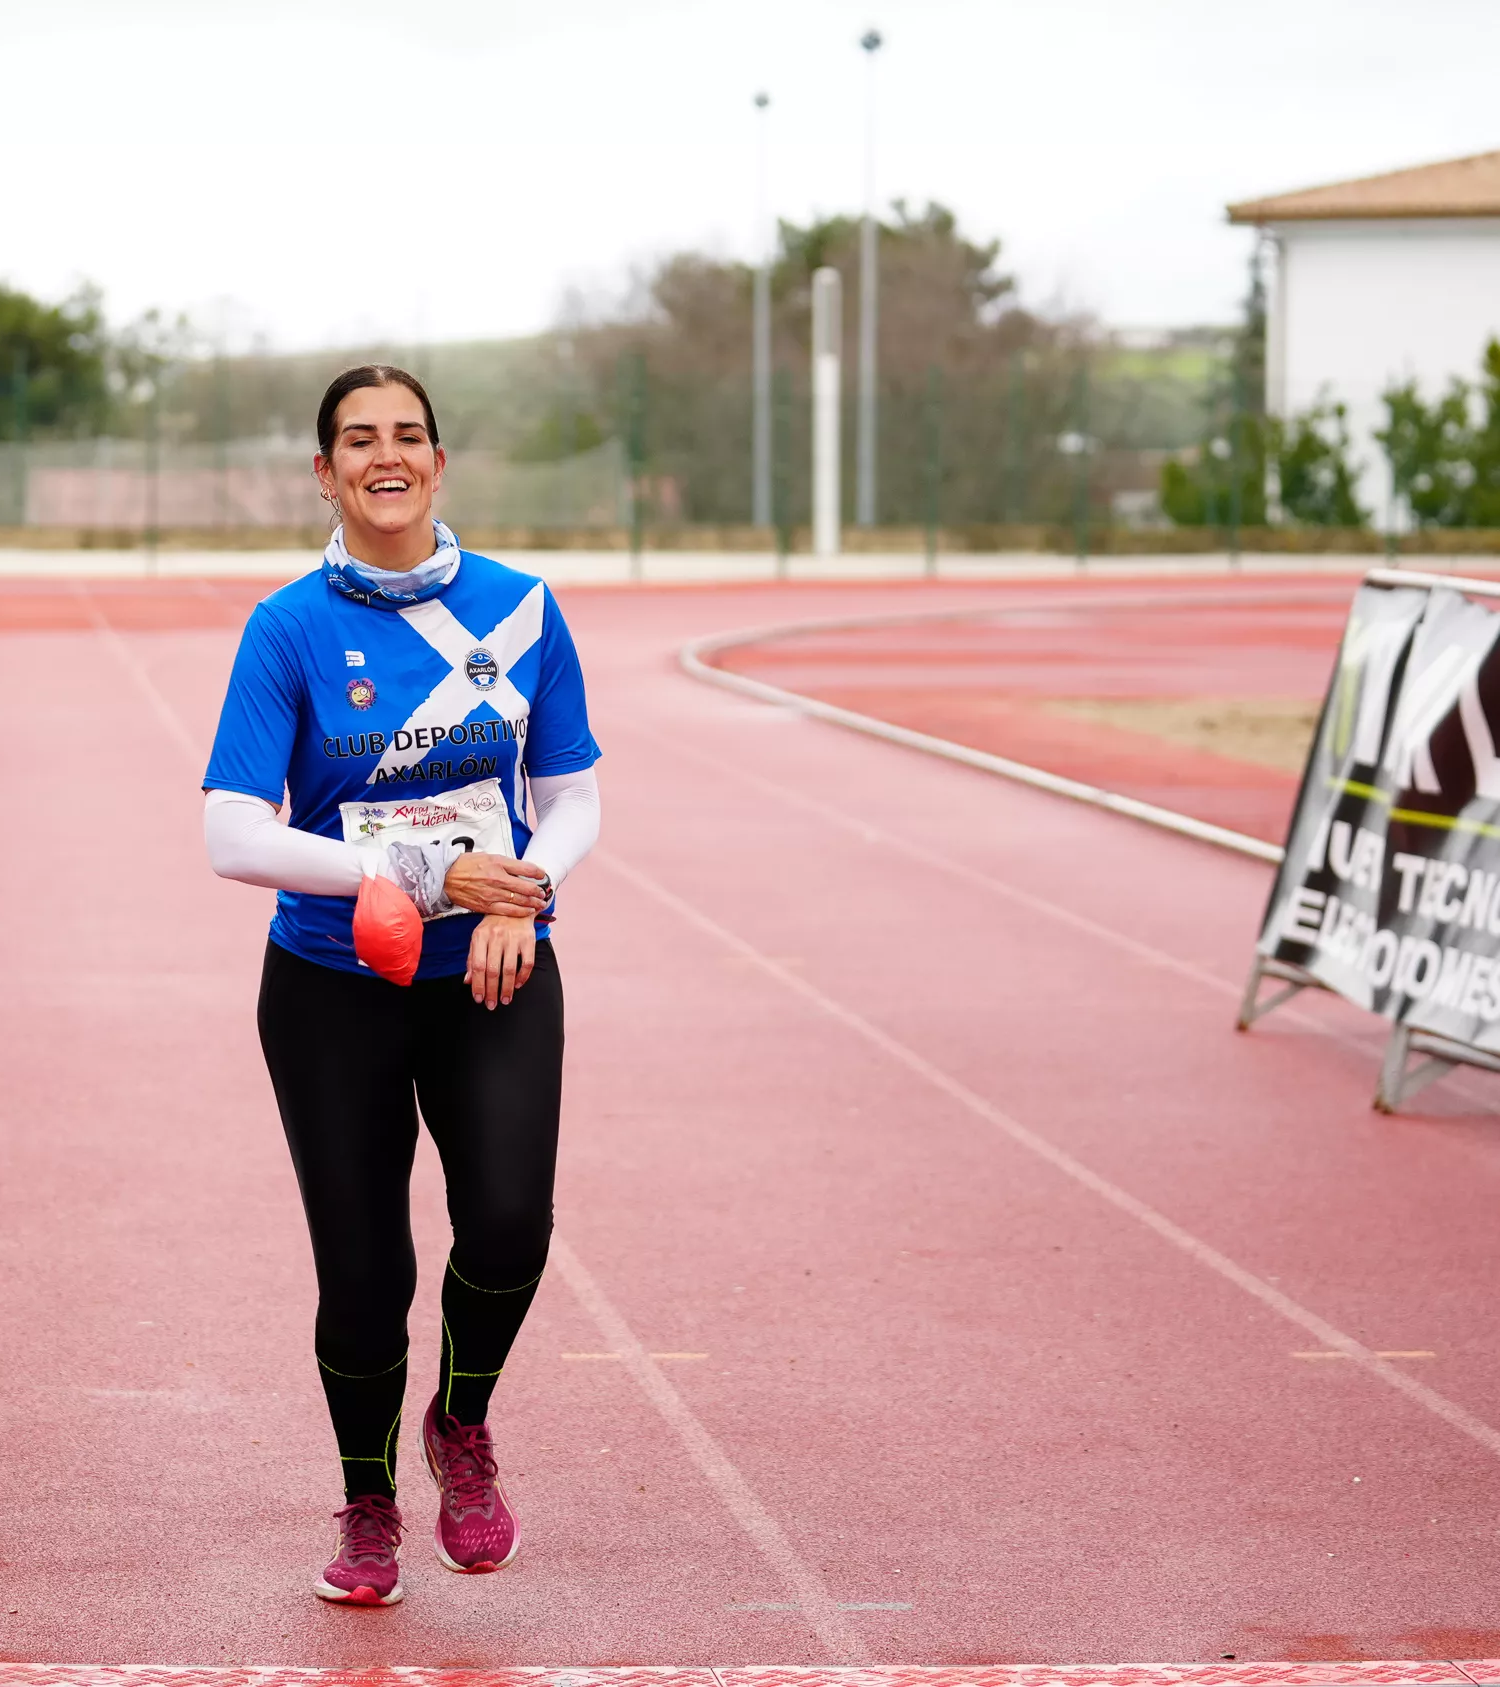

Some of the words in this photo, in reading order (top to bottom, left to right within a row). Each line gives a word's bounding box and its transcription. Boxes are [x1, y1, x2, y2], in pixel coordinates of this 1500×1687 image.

[323, 733, 387, 759] CLUB
[393, 718, 527, 752] DEPORTIVO
[374, 753, 498, 786] AXARLÓN
[412, 811, 459, 827] LUCENA
